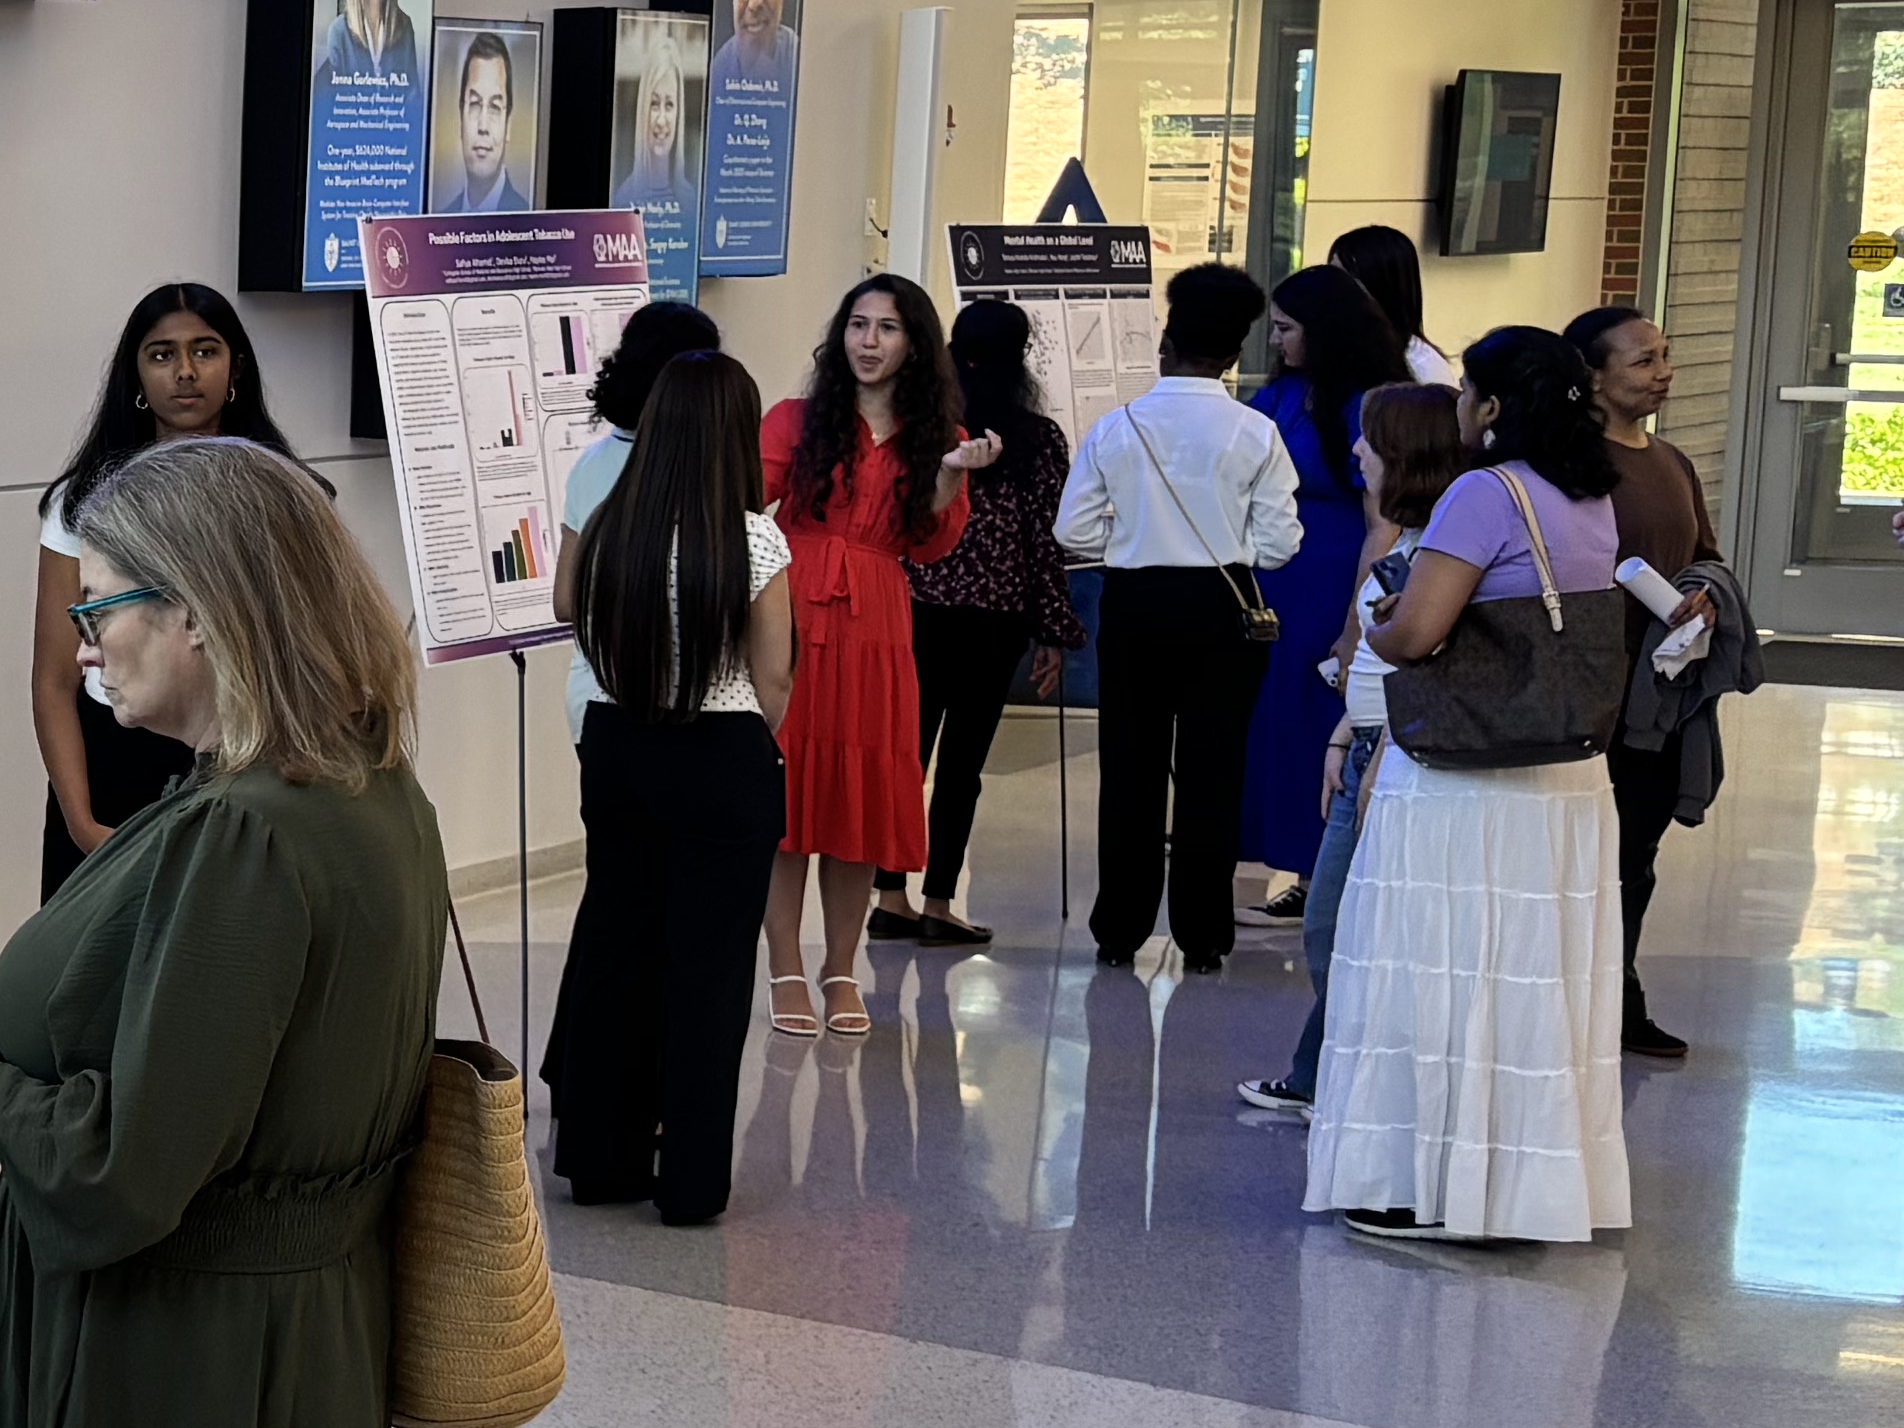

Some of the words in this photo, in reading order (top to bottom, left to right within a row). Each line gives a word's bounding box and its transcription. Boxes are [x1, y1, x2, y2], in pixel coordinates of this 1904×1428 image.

[460, 231, 487, 244] Factors
[607, 233, 642, 261] MAA
[1120, 240, 1146, 263] MAA
